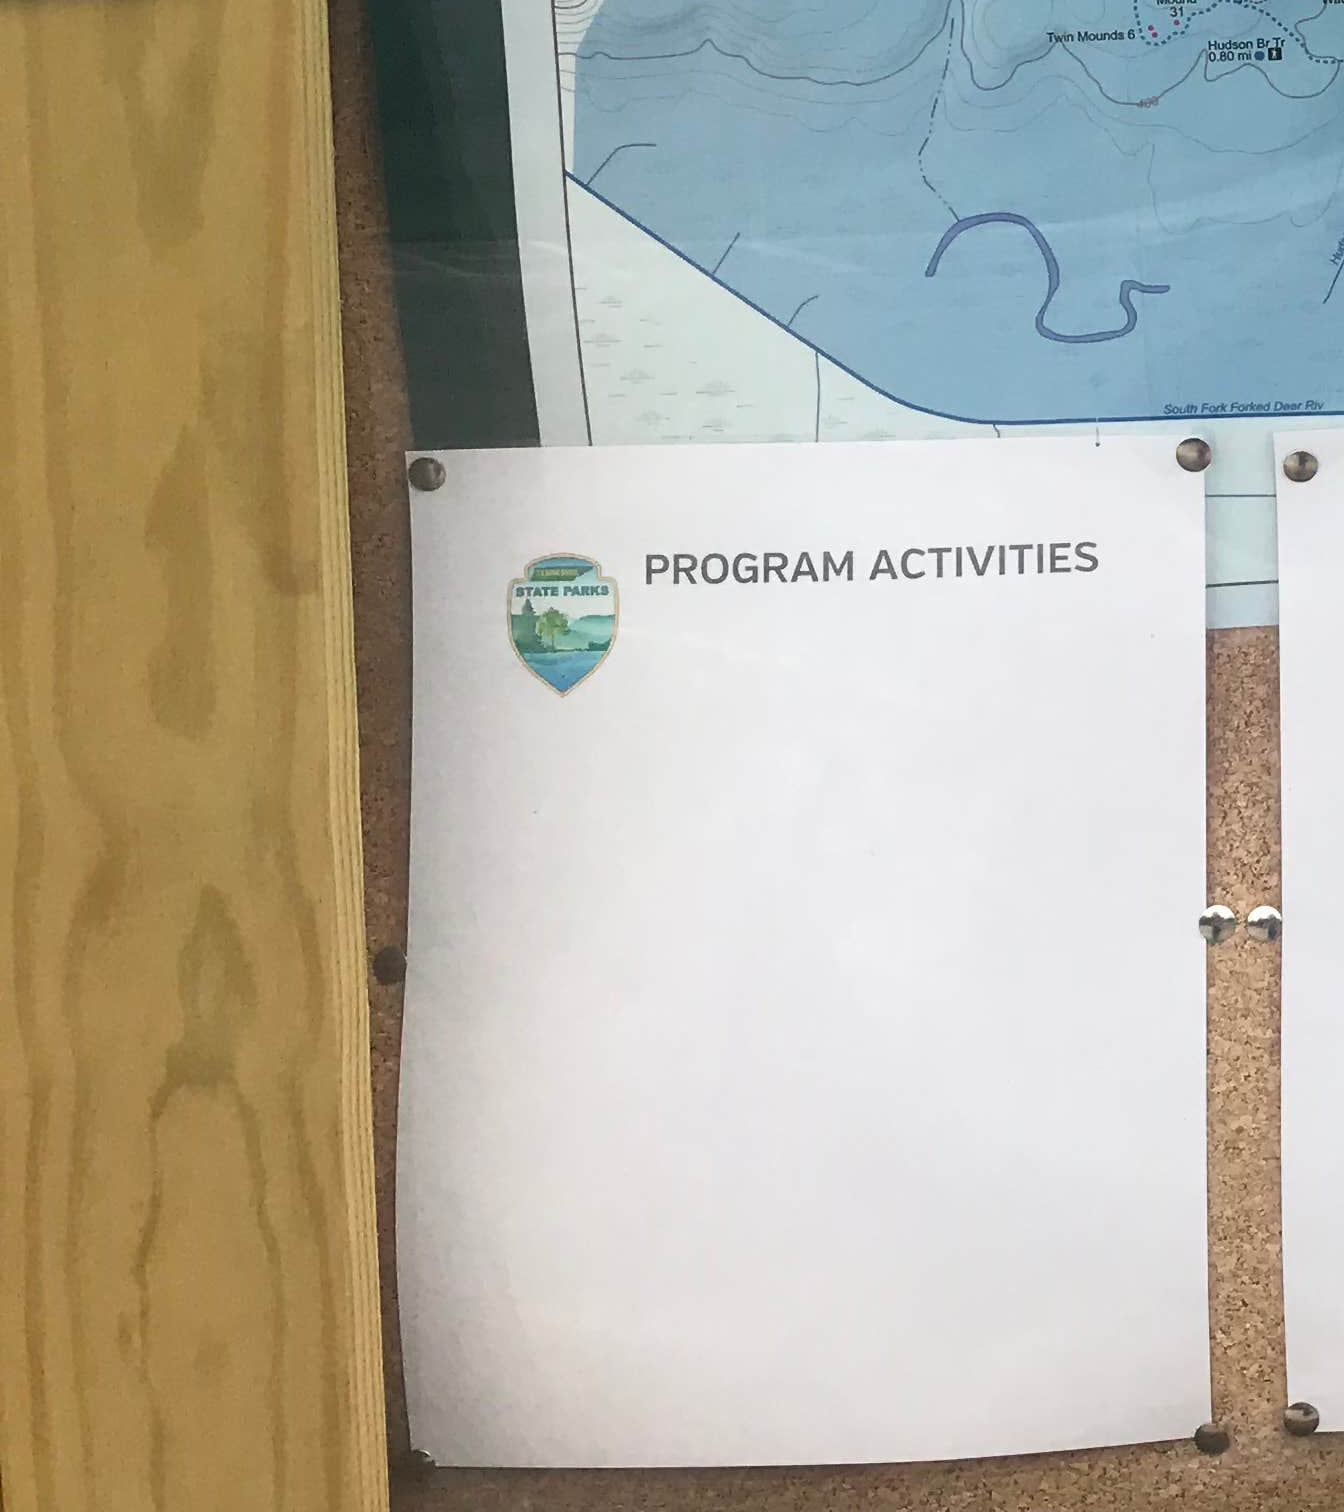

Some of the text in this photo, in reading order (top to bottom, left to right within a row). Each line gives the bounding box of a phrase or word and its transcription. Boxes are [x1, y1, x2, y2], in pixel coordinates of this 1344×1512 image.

[645, 541, 1099, 586] PROGRAM ACTIVITIES
[515, 585, 610, 598] STATE PARKS
